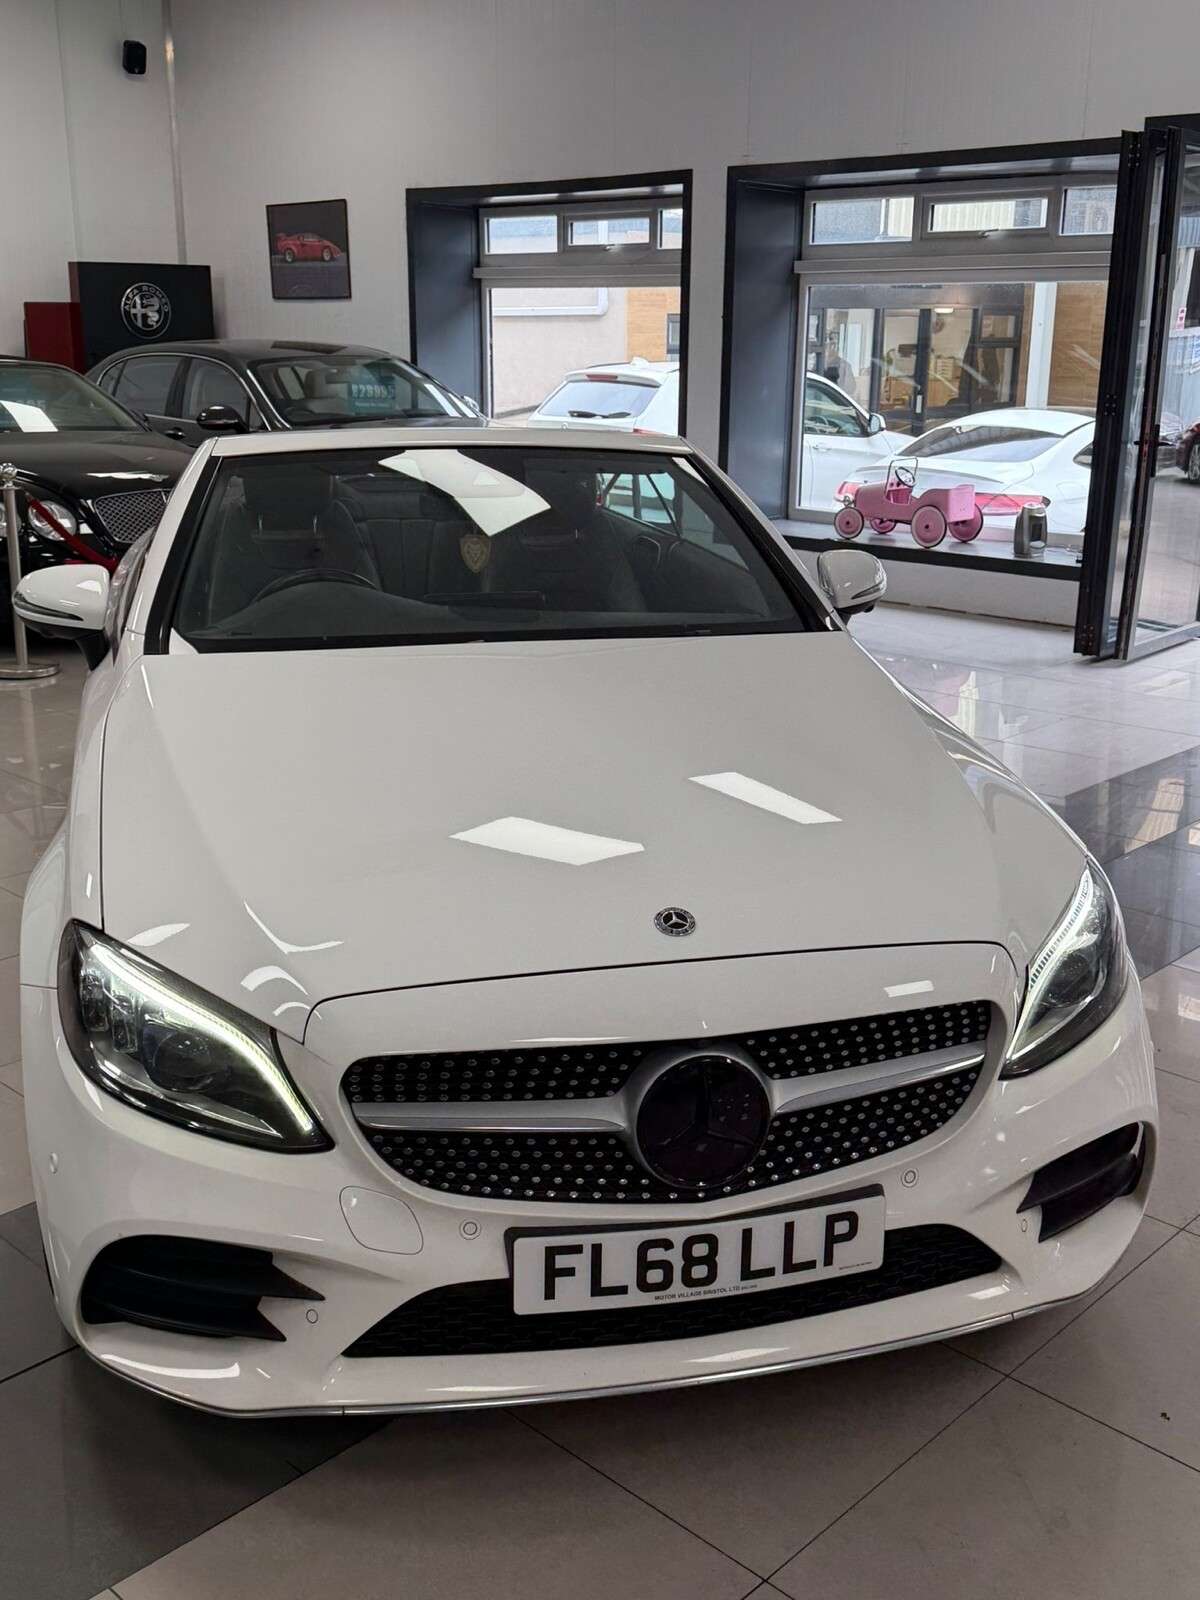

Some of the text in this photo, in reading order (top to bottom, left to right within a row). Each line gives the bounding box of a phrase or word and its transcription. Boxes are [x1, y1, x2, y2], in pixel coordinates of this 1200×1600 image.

[123, 285, 169, 312] ALFA ROMEO
[544, 1210, 859, 1301] FL68 LLP
[678, 1291, 702, 1299] VILLAGE
[703, 1288, 728, 1296] BRISTOL
[728, 1285, 740, 1293] LTD
